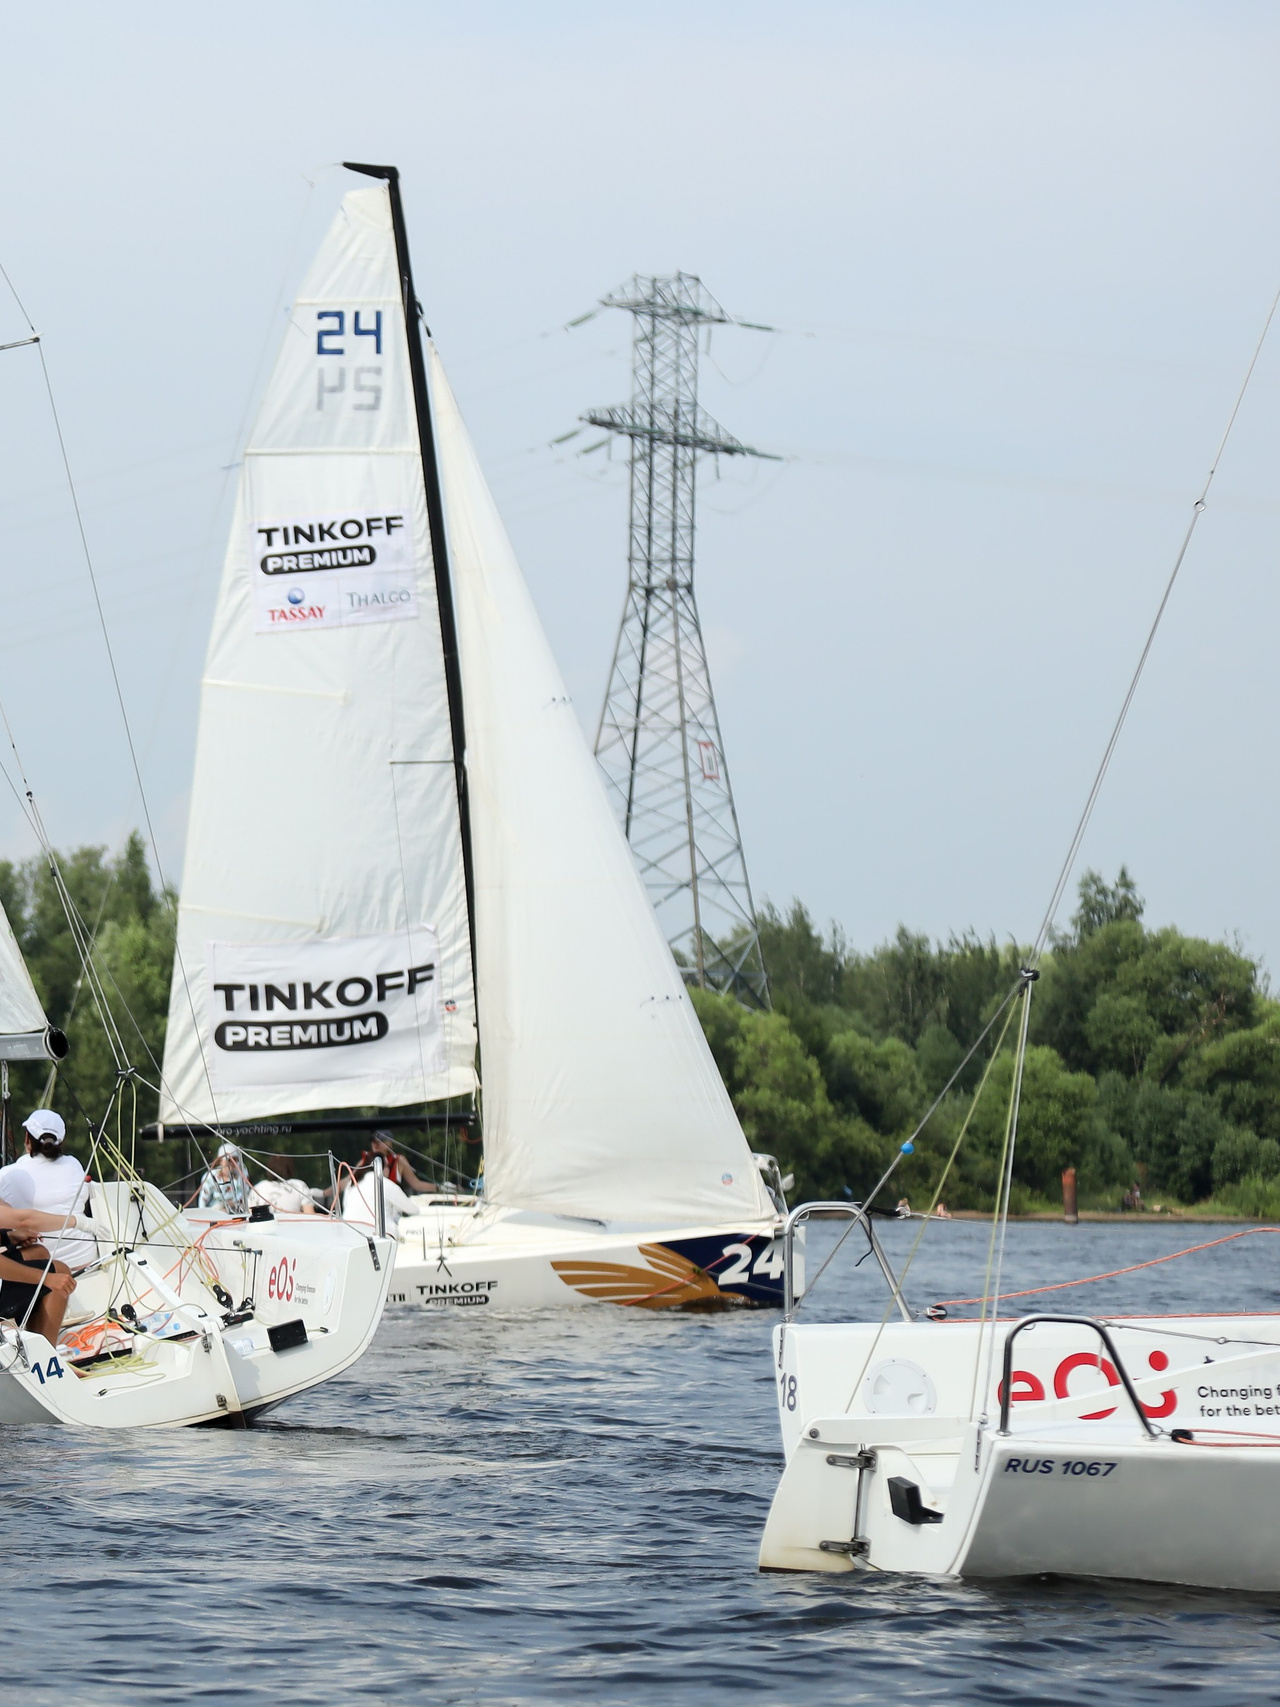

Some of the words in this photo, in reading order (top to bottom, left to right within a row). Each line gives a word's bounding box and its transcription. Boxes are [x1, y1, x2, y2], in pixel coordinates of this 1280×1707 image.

[316, 311, 383, 355] 24
[258, 515, 404, 547] TINKOFF
[265, 547, 373, 573] PREMIUM
[268, 606, 325, 622] TASSAY
[213, 963, 435, 1012] TINKOFF
[224, 1016, 379, 1047] PREMIUM
[214, 1123, 292, 1138] pro-yachting.ru
[718, 1240, 786, 1286] 24
[416, 1280, 499, 1295] TINKOFF
[31, 1356, 64, 1385] 14
[780, 1372, 797, 1412] 18
[1197, 1384, 1273, 1400] Changing
[1199, 1405, 1224, 1417] for
[1226, 1404, 1251, 1416] the
[1004, 1458, 1055, 1475] RUS
[1061, 1460, 1117, 1477] 1067
